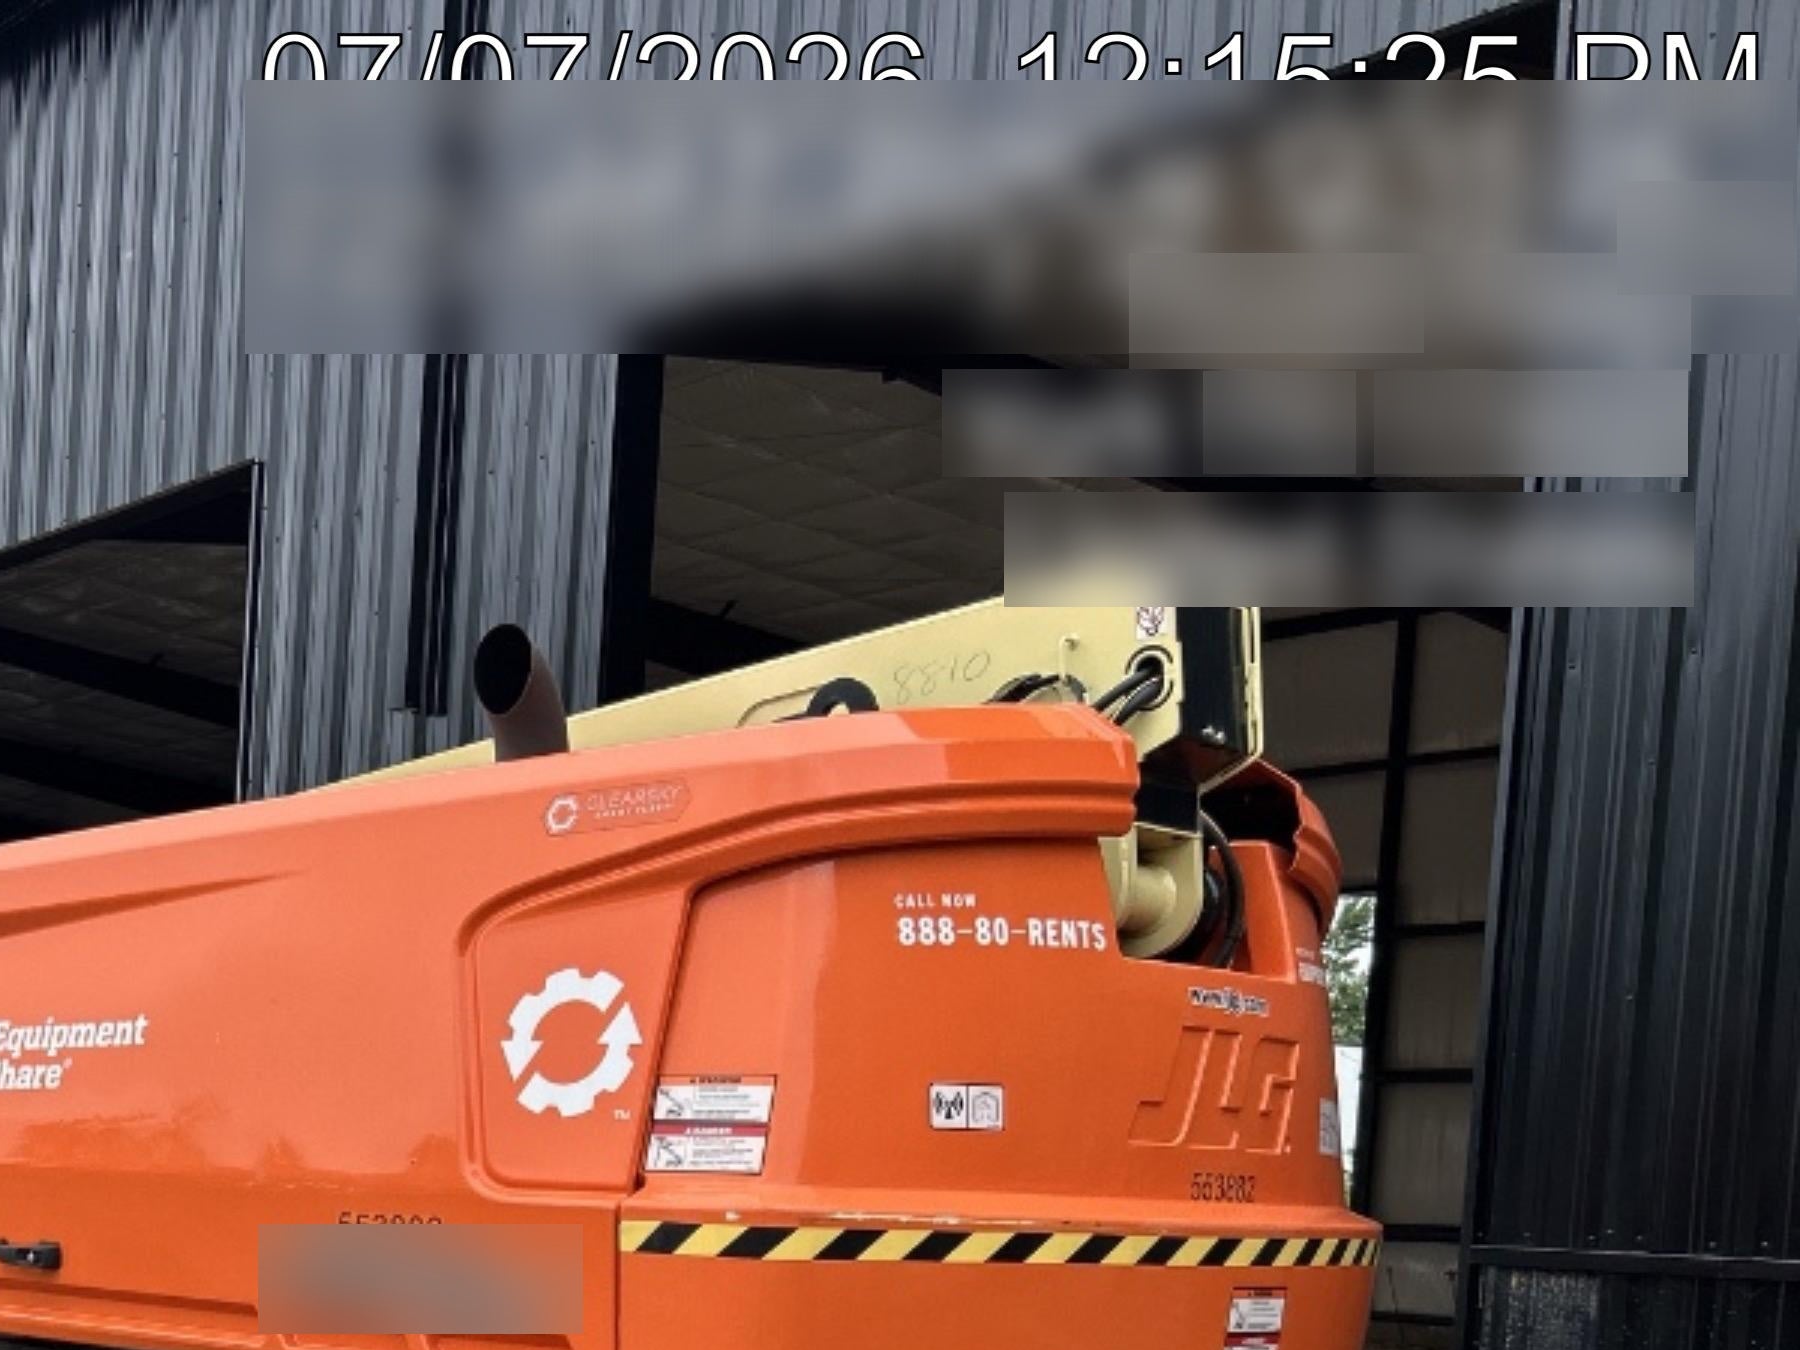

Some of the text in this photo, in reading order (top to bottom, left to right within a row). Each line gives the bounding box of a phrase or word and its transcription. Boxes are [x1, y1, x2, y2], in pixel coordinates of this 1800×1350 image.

[894, 893, 977, 909] CALL NOW
[897, 915, 1107, 952] 888-80-RENTS
